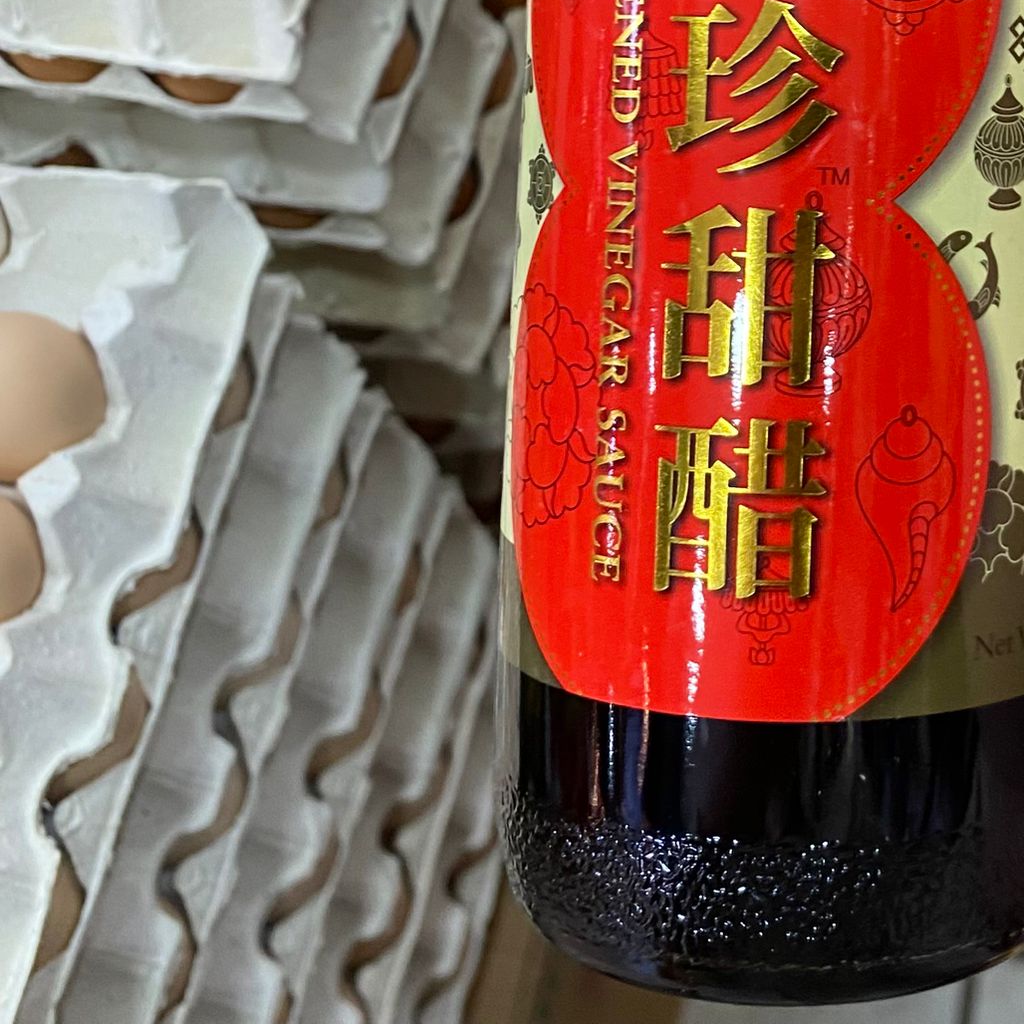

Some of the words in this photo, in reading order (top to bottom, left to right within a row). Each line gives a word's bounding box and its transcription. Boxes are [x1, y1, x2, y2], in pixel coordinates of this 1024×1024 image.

[597, 141, 639, 384] VINEGAR
[816, 166, 850, 186] TM
[592, 408, 627, 582] SAUCE
